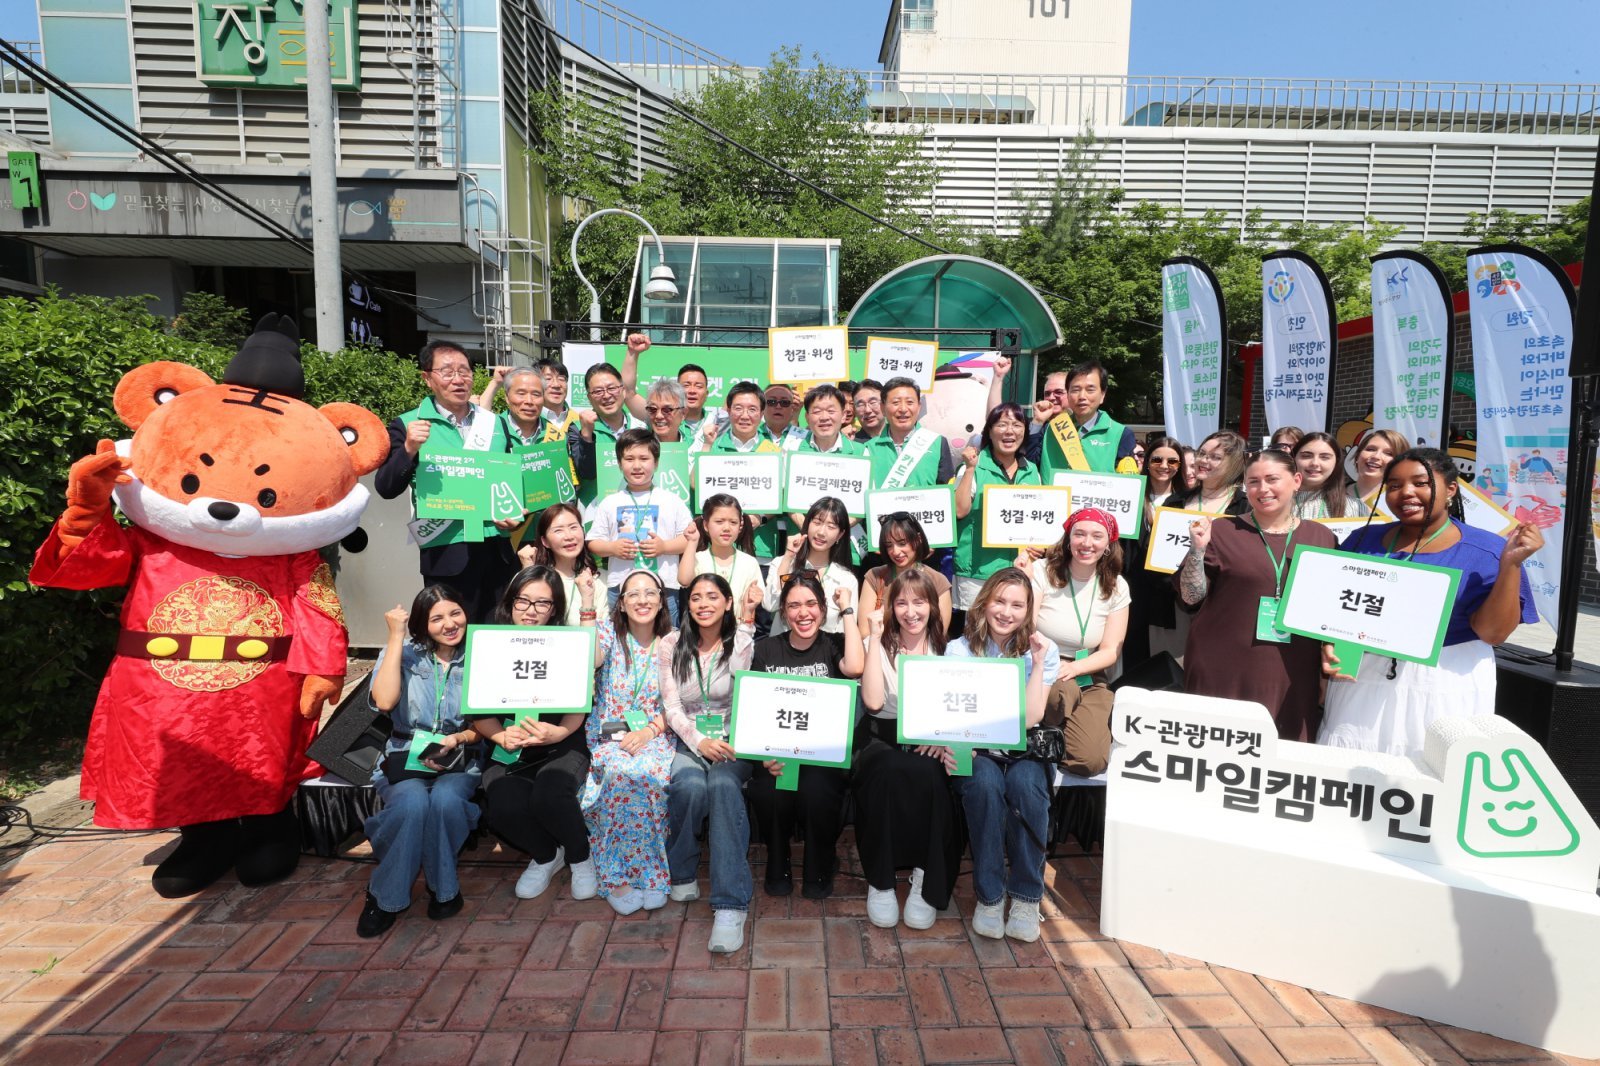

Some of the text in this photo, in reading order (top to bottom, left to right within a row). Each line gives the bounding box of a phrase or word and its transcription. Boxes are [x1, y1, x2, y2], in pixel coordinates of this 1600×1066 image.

[12, 158, 33, 167] GATE
[123, 194, 185, 213] 믿고찾는
[243, 198, 297, 216] 시찾는
[425, 464, 485, 479] 스마일캠페인
[705, 475, 773, 491] 카드결제환영
[795, 474, 863, 494] 카드결제환영
[1071, 494, 1132, 514] 드결제환영
[999, 508, 1055, 525] 청결·위생
[1341, 564, 1387, 579] 스마일캠페인
[1339, 588, 1386, 617] 친절
[512, 659, 548, 680] 친절
[942, 690, 978, 713] 친절
[775, 708, 810, 731] 친절
[1124, 714, 1263, 758] K-관광마켓
[1120, 749, 1435, 844] 스마일캠페인
